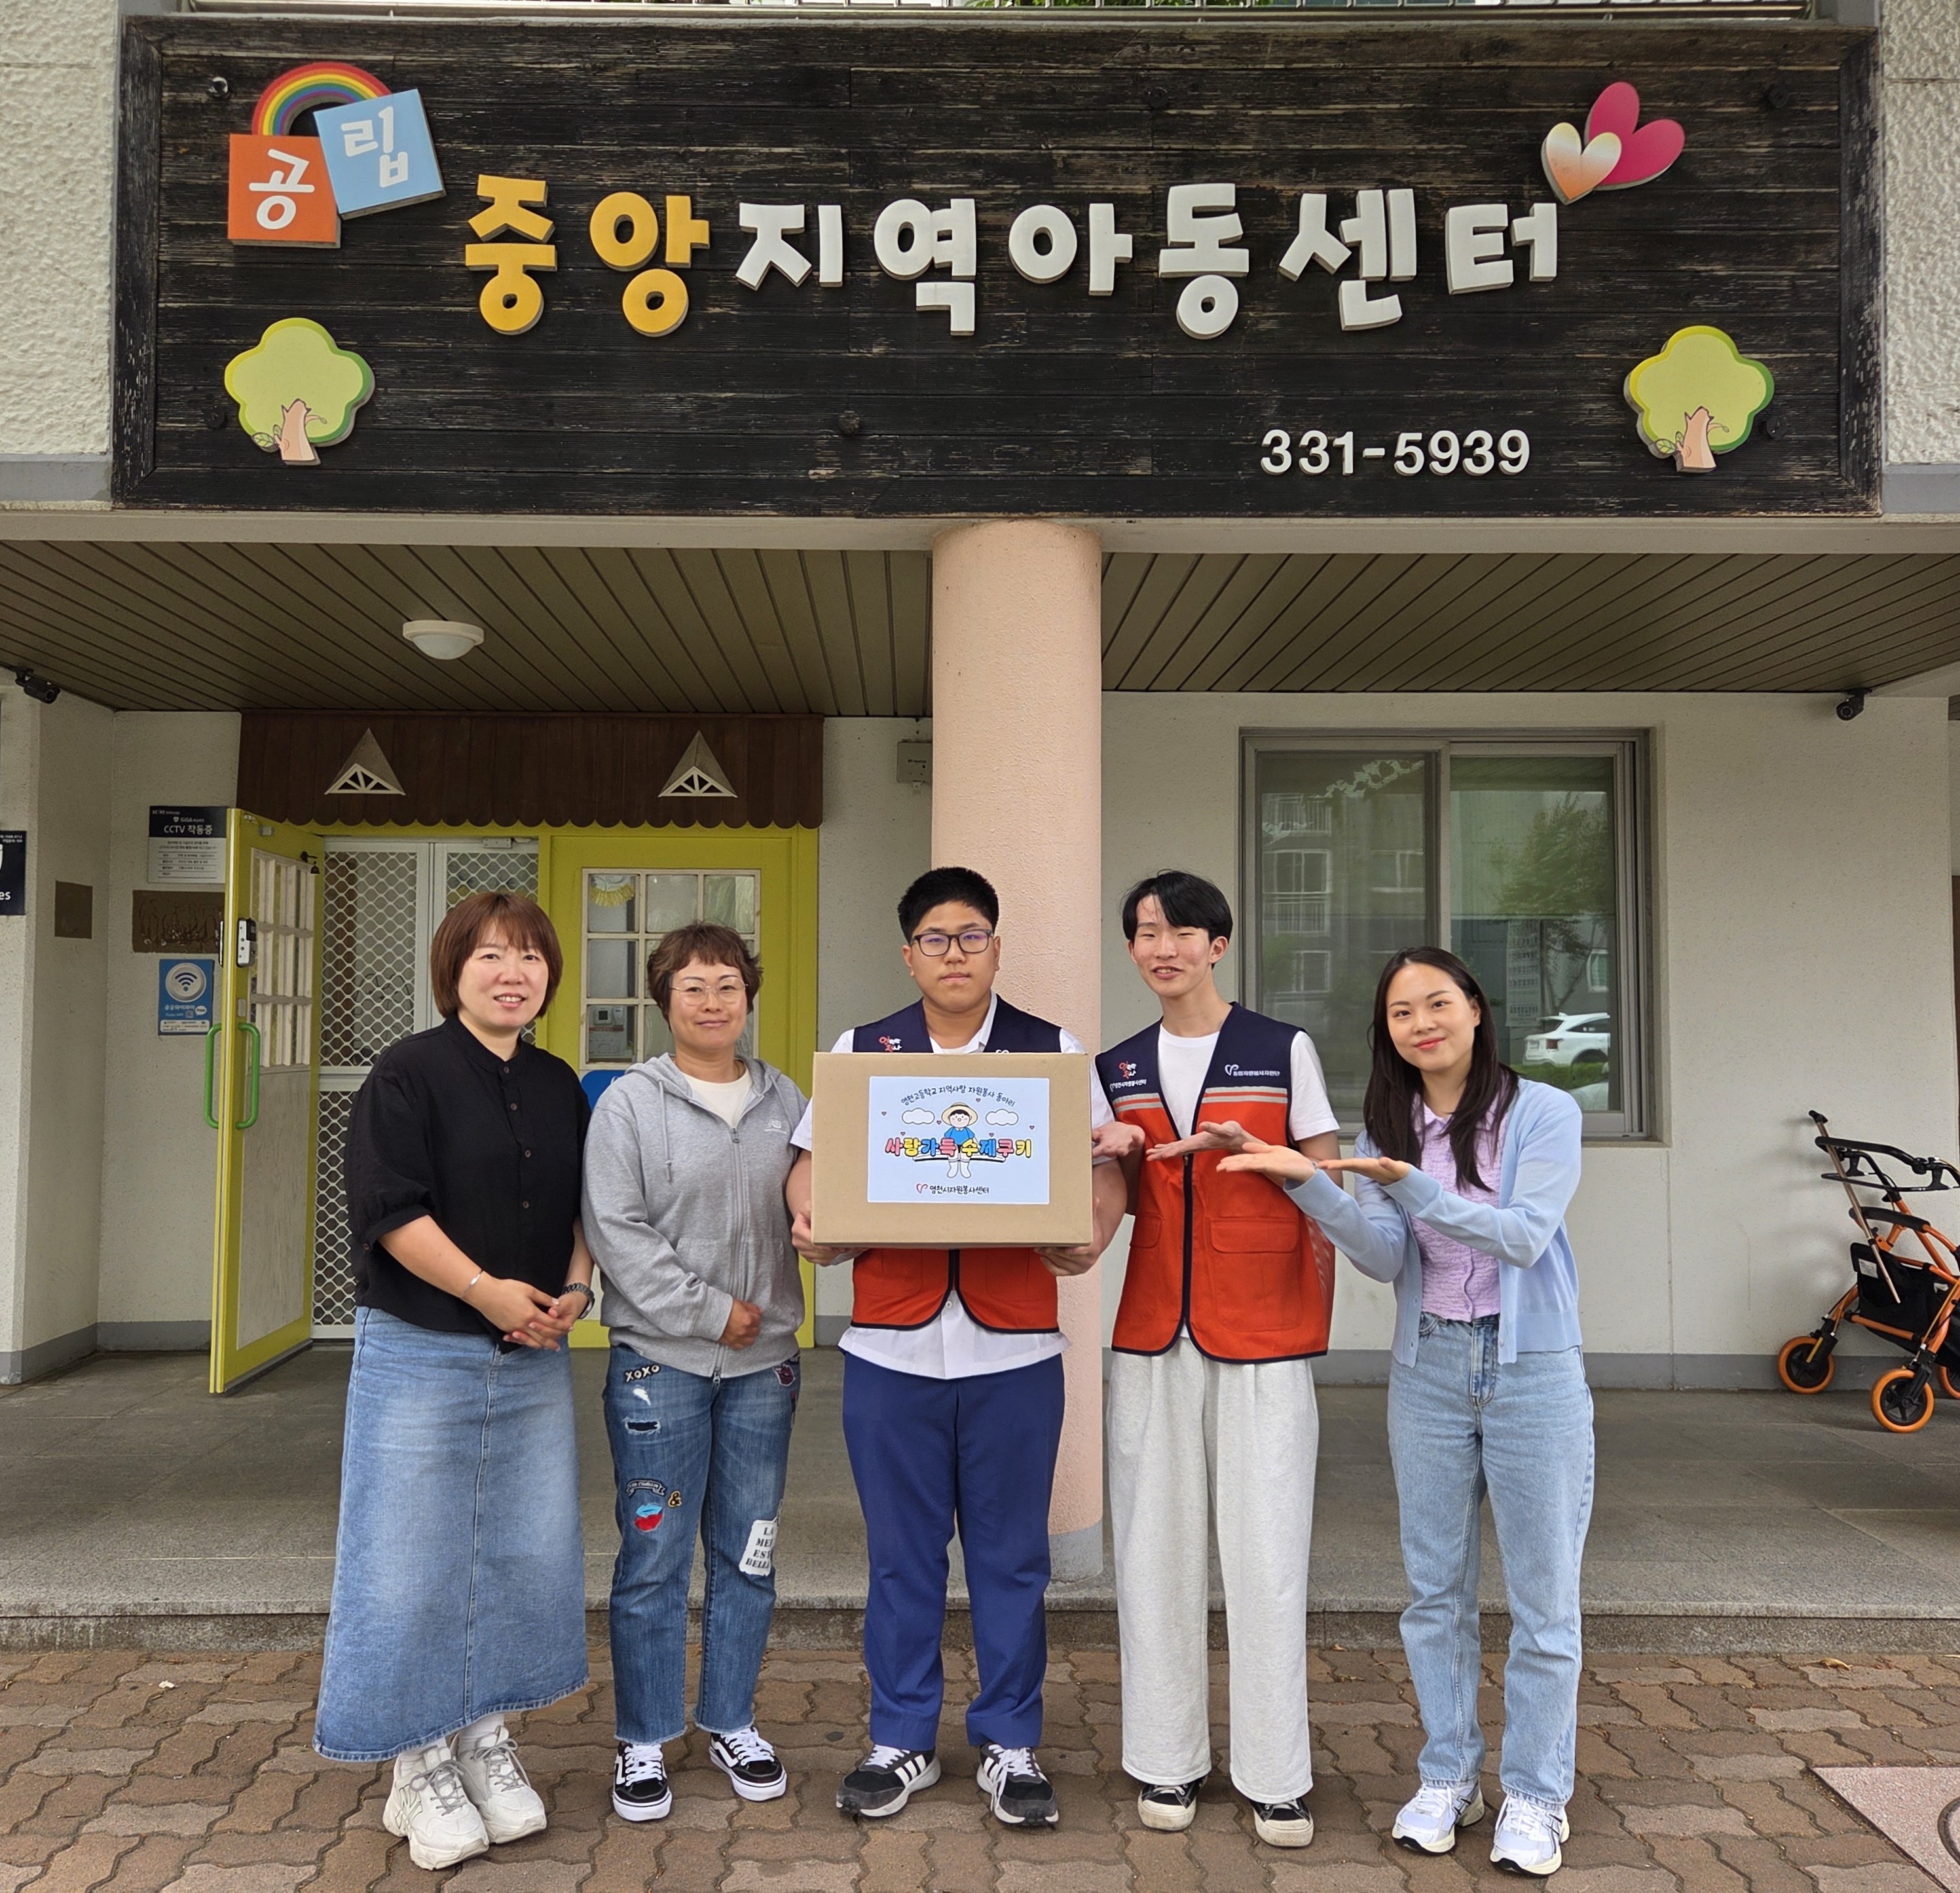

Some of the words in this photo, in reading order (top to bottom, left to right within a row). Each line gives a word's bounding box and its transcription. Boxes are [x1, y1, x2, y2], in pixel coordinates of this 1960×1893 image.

[465, 174, 711, 338] 중앙
[1260, 428, 1531, 477] 331-5939
[188, 825, 213, 835] 작동중
[900, 1087, 937, 1106] 영천고등학교
[938, 1084, 967, 1094] 지역사랑
[968, 1086, 995, 1098] 자원봉사
[996, 1092, 1016, 1107] 동아리
[885, 1137, 957, 1157] 사랑가득
[961, 1138, 1032, 1158] 수제쿠키
[929, 1185, 989, 1194] 영천시자원봉사센터
[625, 1365, 659, 1383] XOXO
